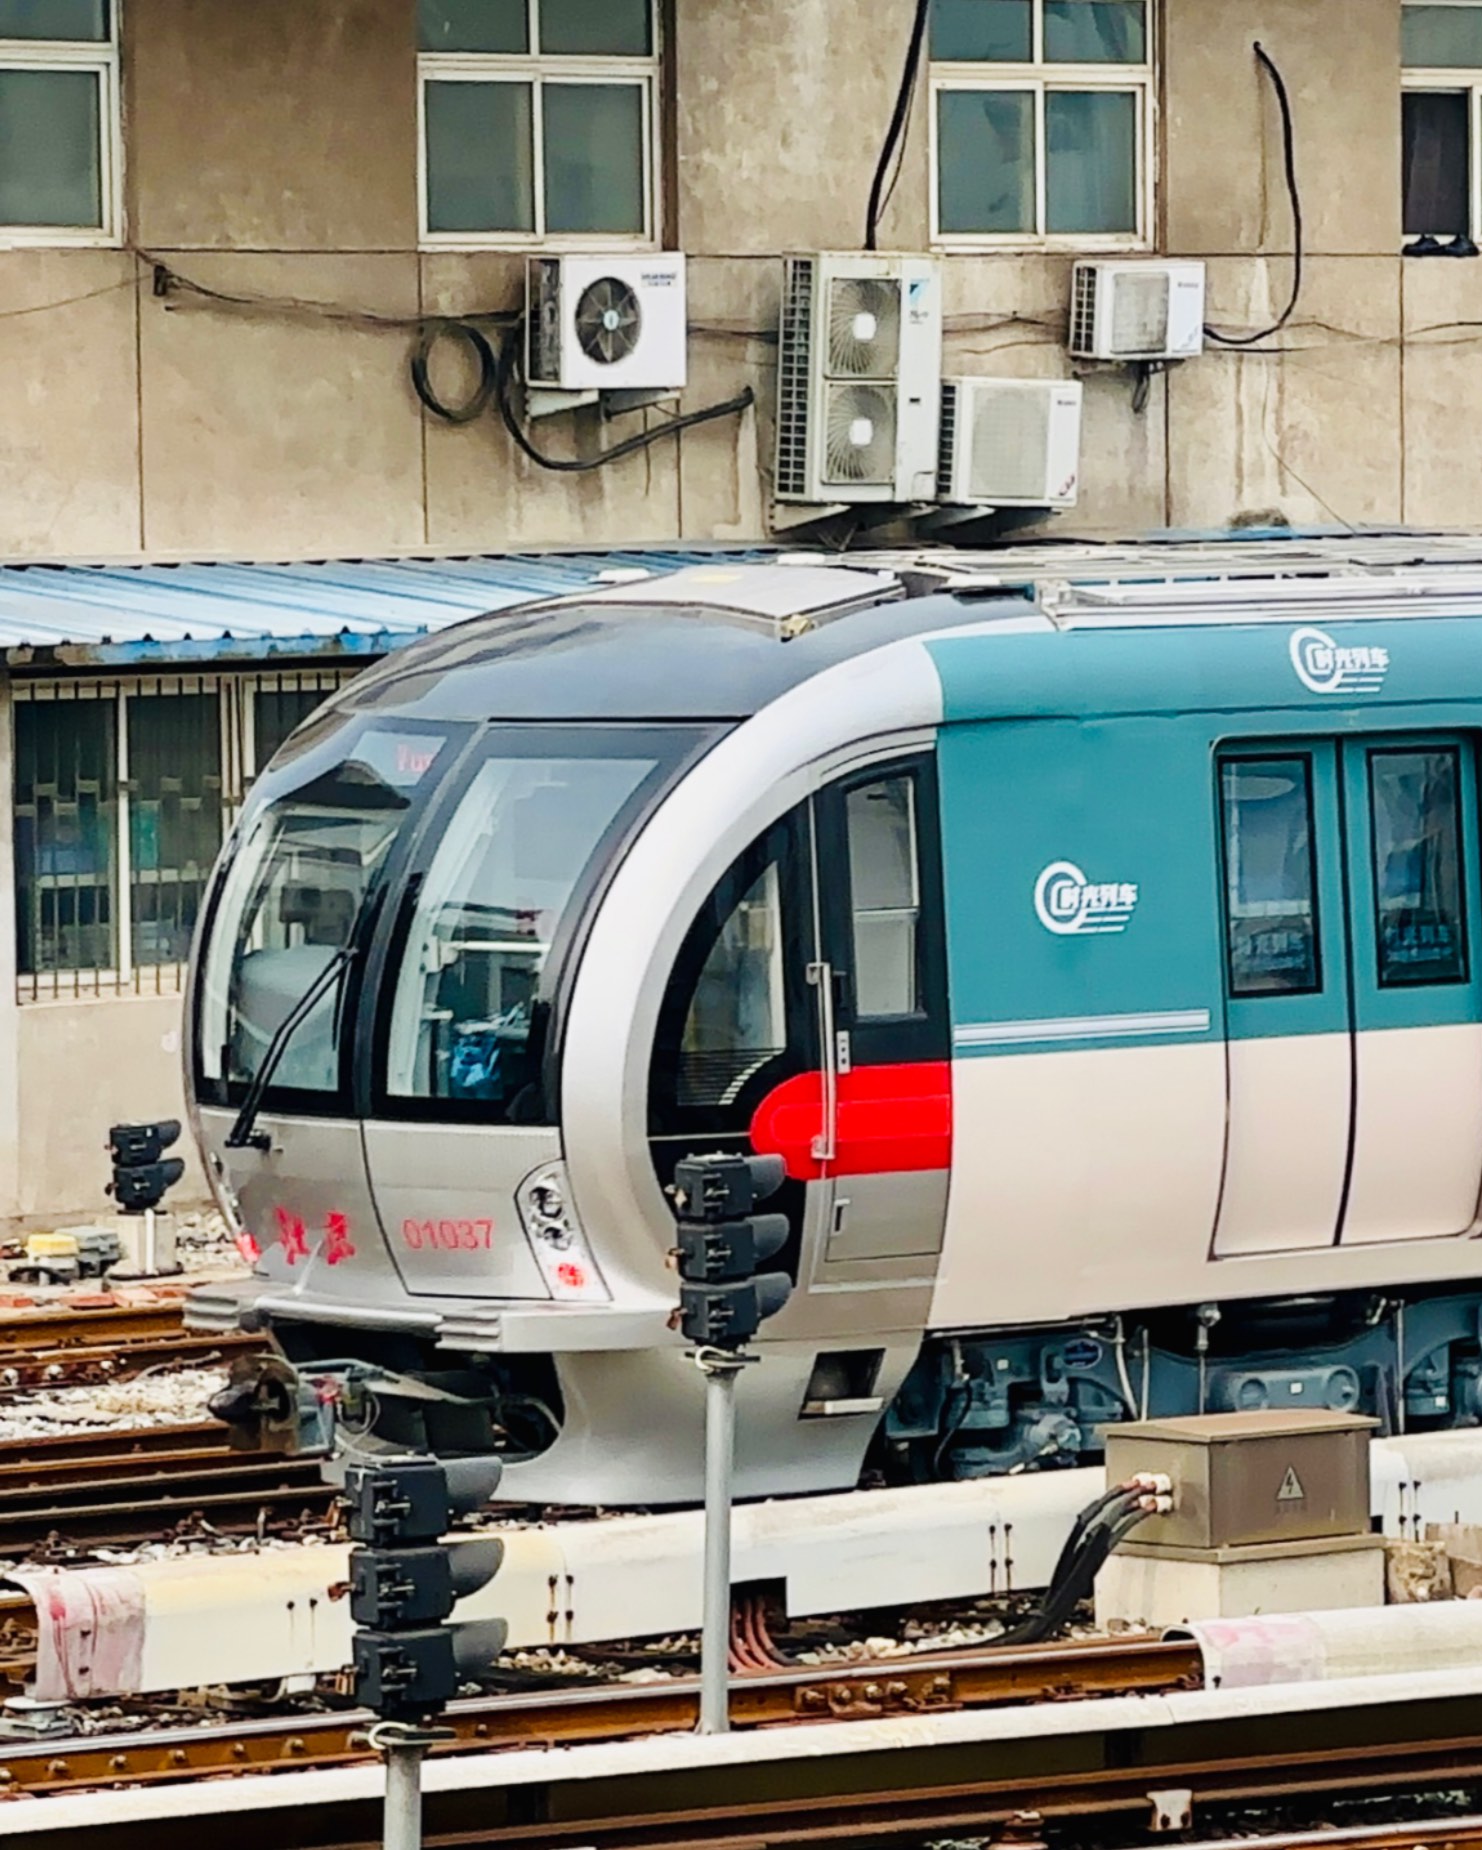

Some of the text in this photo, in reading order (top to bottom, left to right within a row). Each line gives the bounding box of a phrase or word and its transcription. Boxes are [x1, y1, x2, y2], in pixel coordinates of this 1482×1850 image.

[1314, 647, 1390, 670] 时光列车
[1060, 883, 1138, 908] 时光列车
[402, 1218, 494, 1250] 01037
